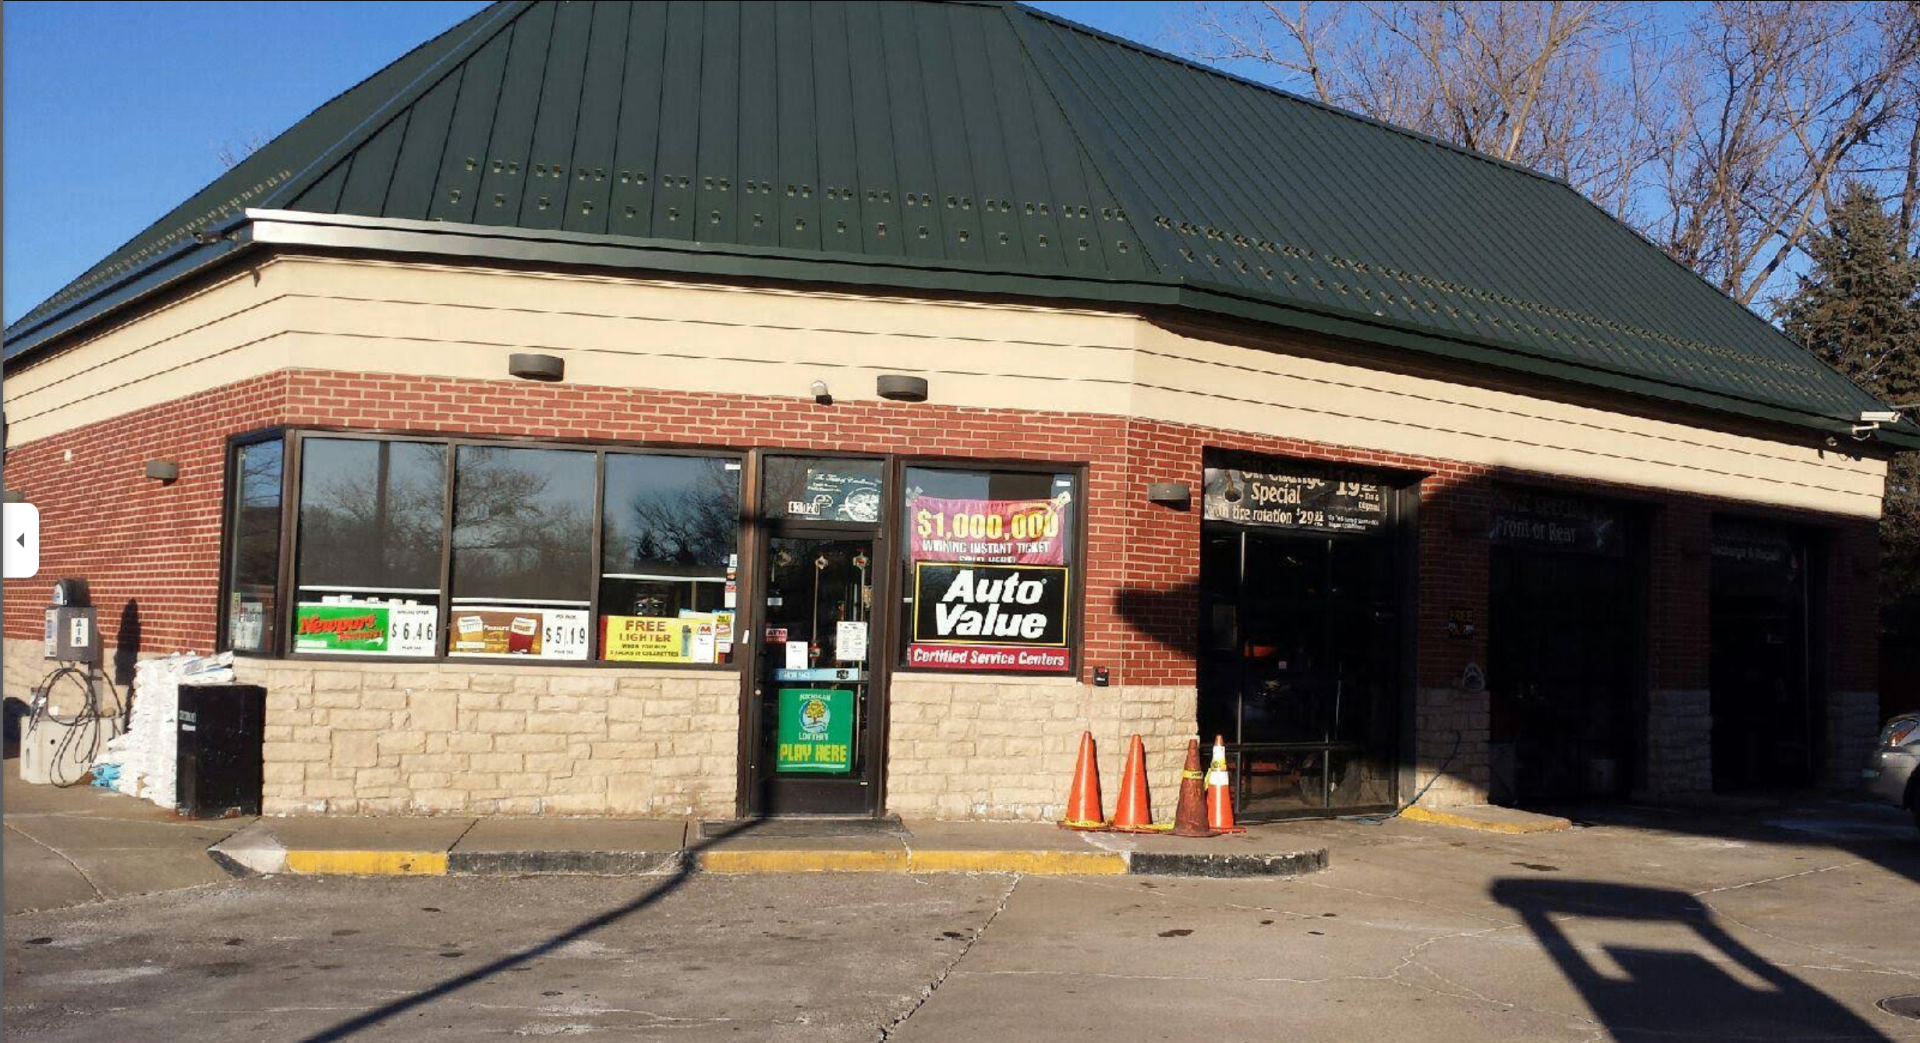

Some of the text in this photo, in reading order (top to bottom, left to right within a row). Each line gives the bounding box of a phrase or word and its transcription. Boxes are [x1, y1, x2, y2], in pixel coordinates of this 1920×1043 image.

[1251, 482, 1301, 506] Special
[1232, 505, 1251, 520] tire
[1253, 508, 1293, 524] rotation
[917, 508, 1059, 541] $1,000,000
[1496, 517, 1577, 544] Front or Rear
[922, 539, 1051, 555] WINNING INSTANT TICKET
[941, 569, 1044, 605] Auto
[299, 614, 376, 635] Newport
[625, 620, 666, 632] FREE
[936, 603, 1048, 639] Value
[619, 633, 671, 643] LIGHTER
[914, 648, 1065, 666] Certified Service Centers
[798, 732, 829, 741] LOTTERY
[779, 743, 847, 762] PLAY HERE
